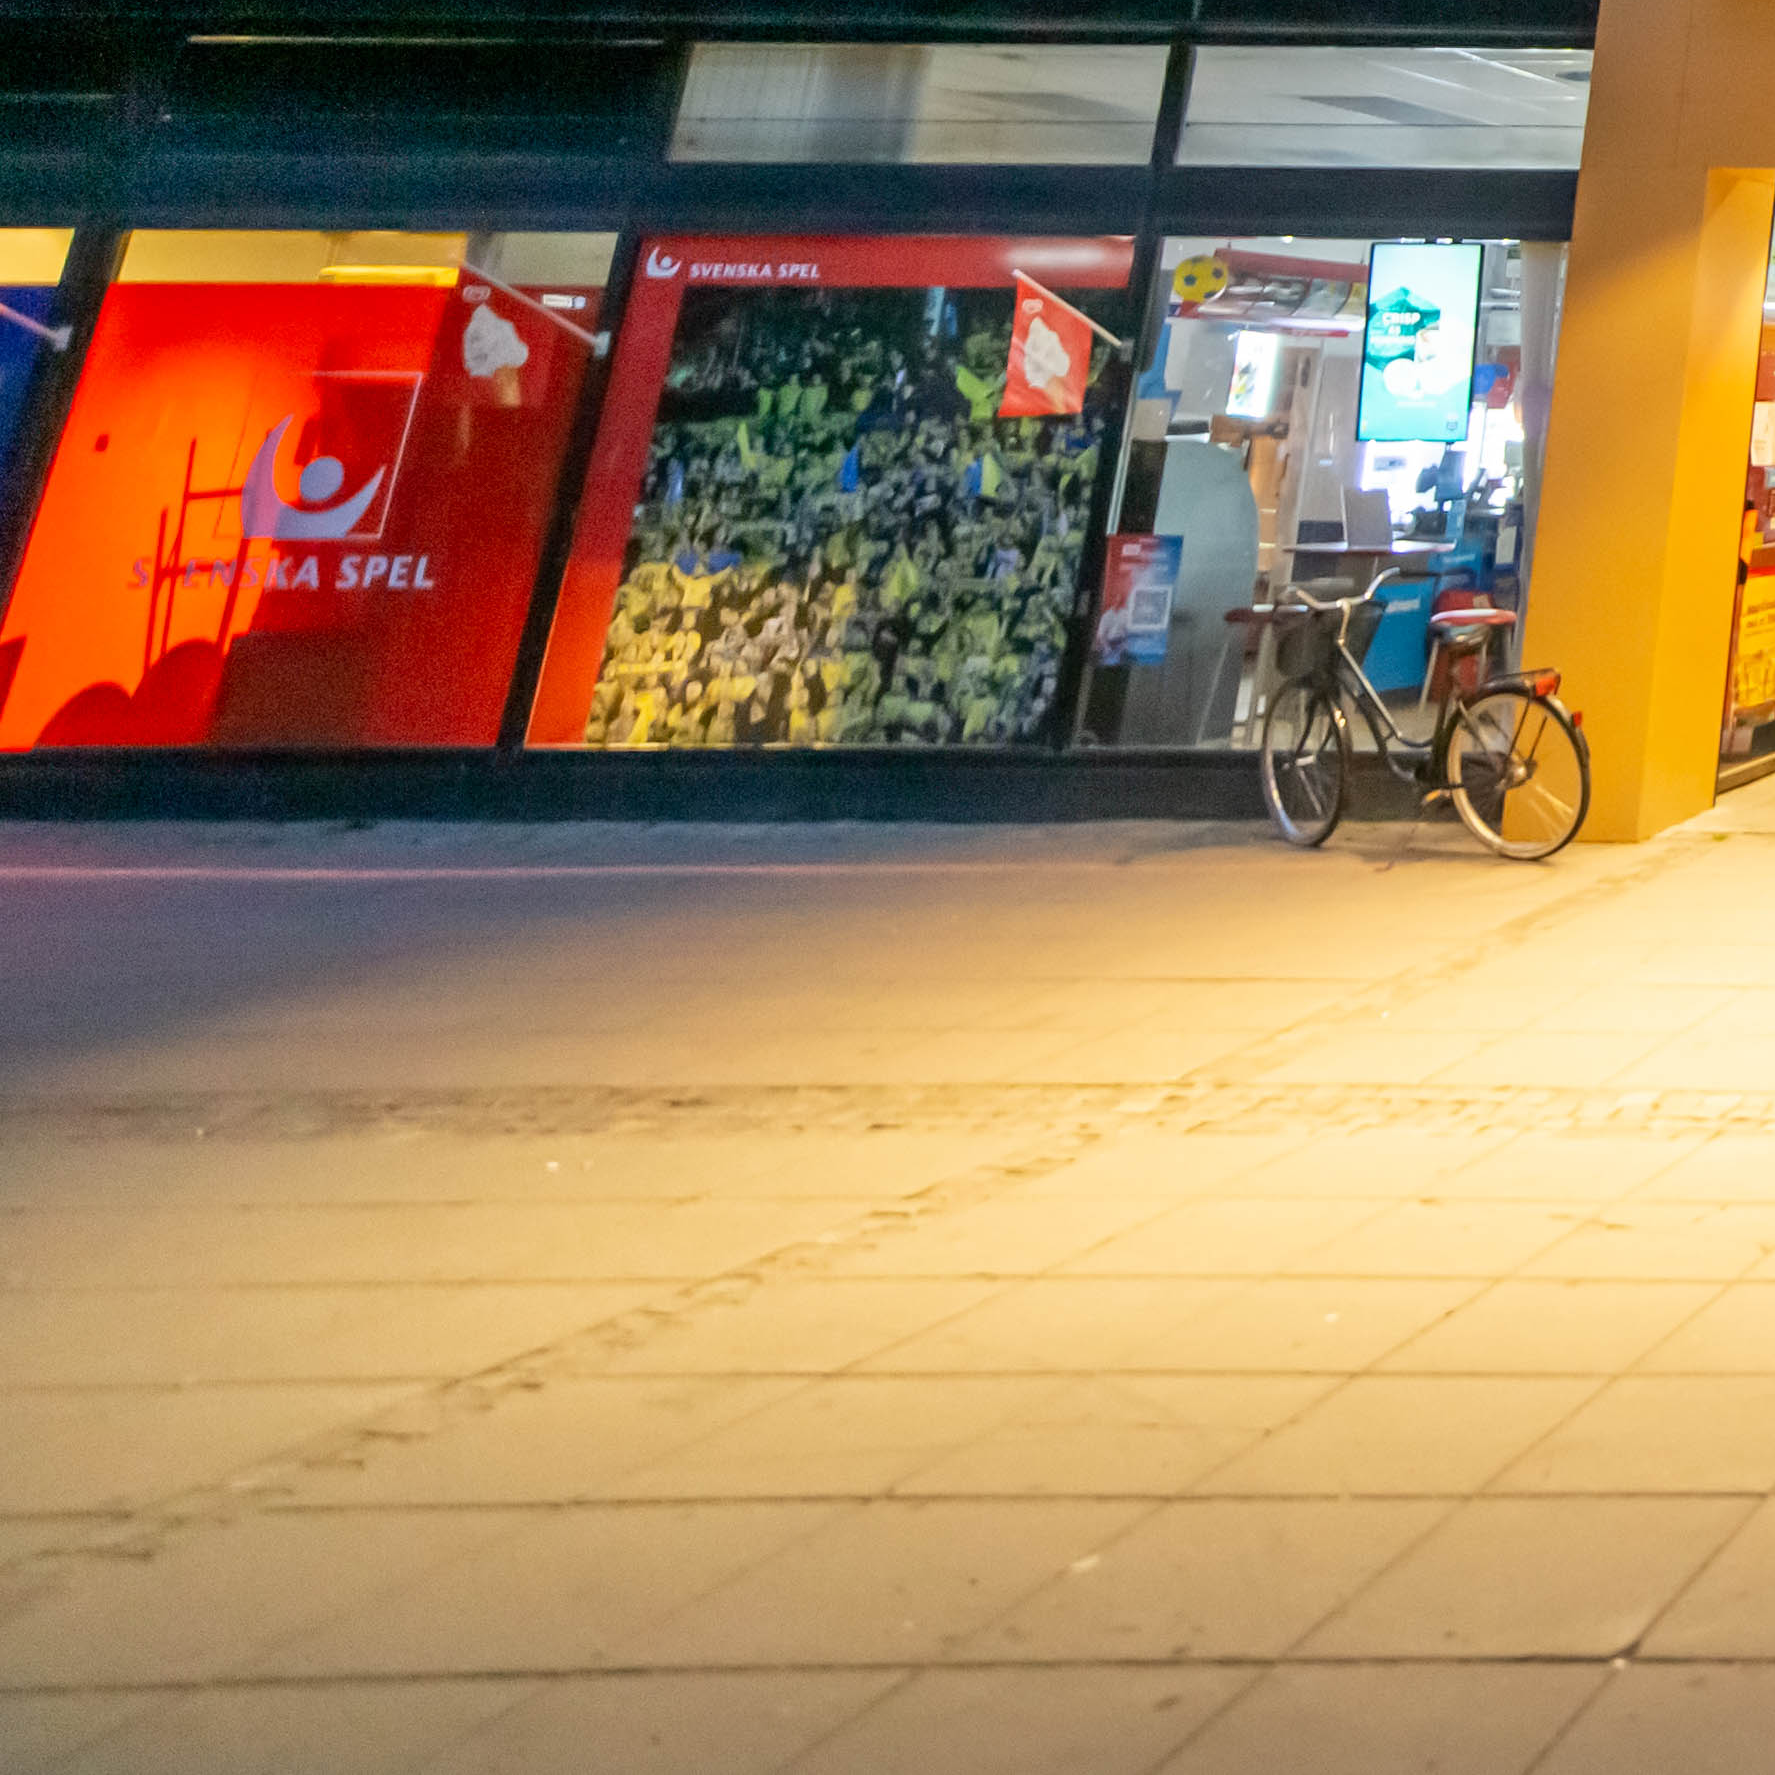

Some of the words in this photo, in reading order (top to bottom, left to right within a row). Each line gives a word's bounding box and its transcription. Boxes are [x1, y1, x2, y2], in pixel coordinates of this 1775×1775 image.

[690, 263, 772, 278] SVENSKA
[778, 263, 820, 278] SPEL
[127, 554, 320, 590] SENSKA
[335, 554, 435, 590] SPEL
